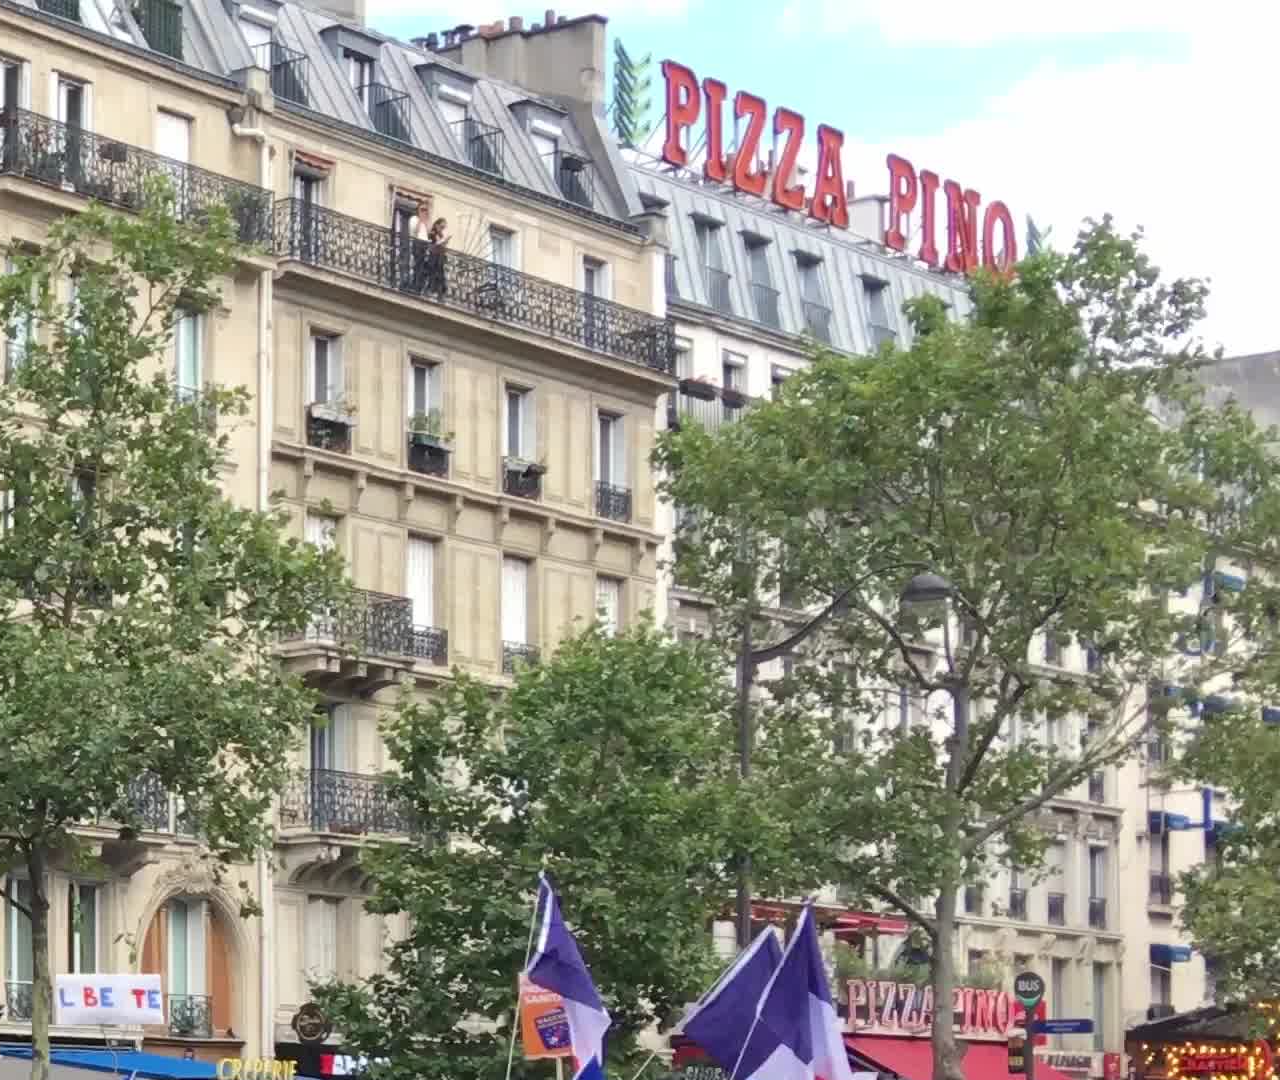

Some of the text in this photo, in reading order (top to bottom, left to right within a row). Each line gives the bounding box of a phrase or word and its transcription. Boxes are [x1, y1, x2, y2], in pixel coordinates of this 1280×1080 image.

[660, 58, 1018, 281] PIZZA PINO
[846, 979, 933, 1033] PIZZA
[1018, 980, 1039, 992] BUS
